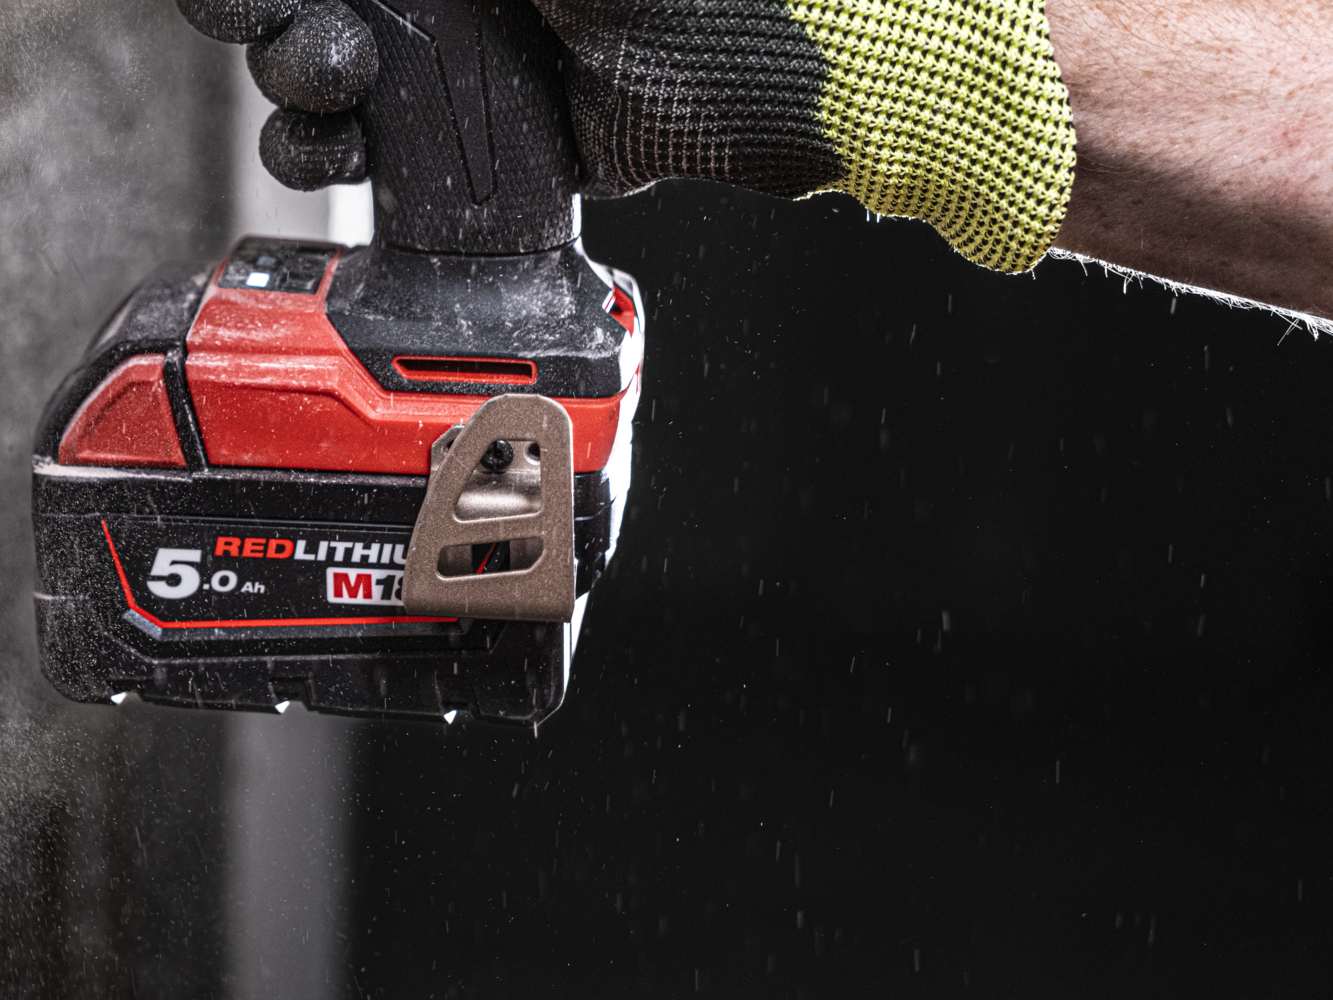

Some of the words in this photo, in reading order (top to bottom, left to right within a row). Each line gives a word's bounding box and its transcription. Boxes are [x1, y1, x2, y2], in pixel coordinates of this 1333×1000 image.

[214, 535, 408, 565] REDLITHIU
[146, 547, 238, 600] 5.0
[240, 581, 266, 594] Ah
